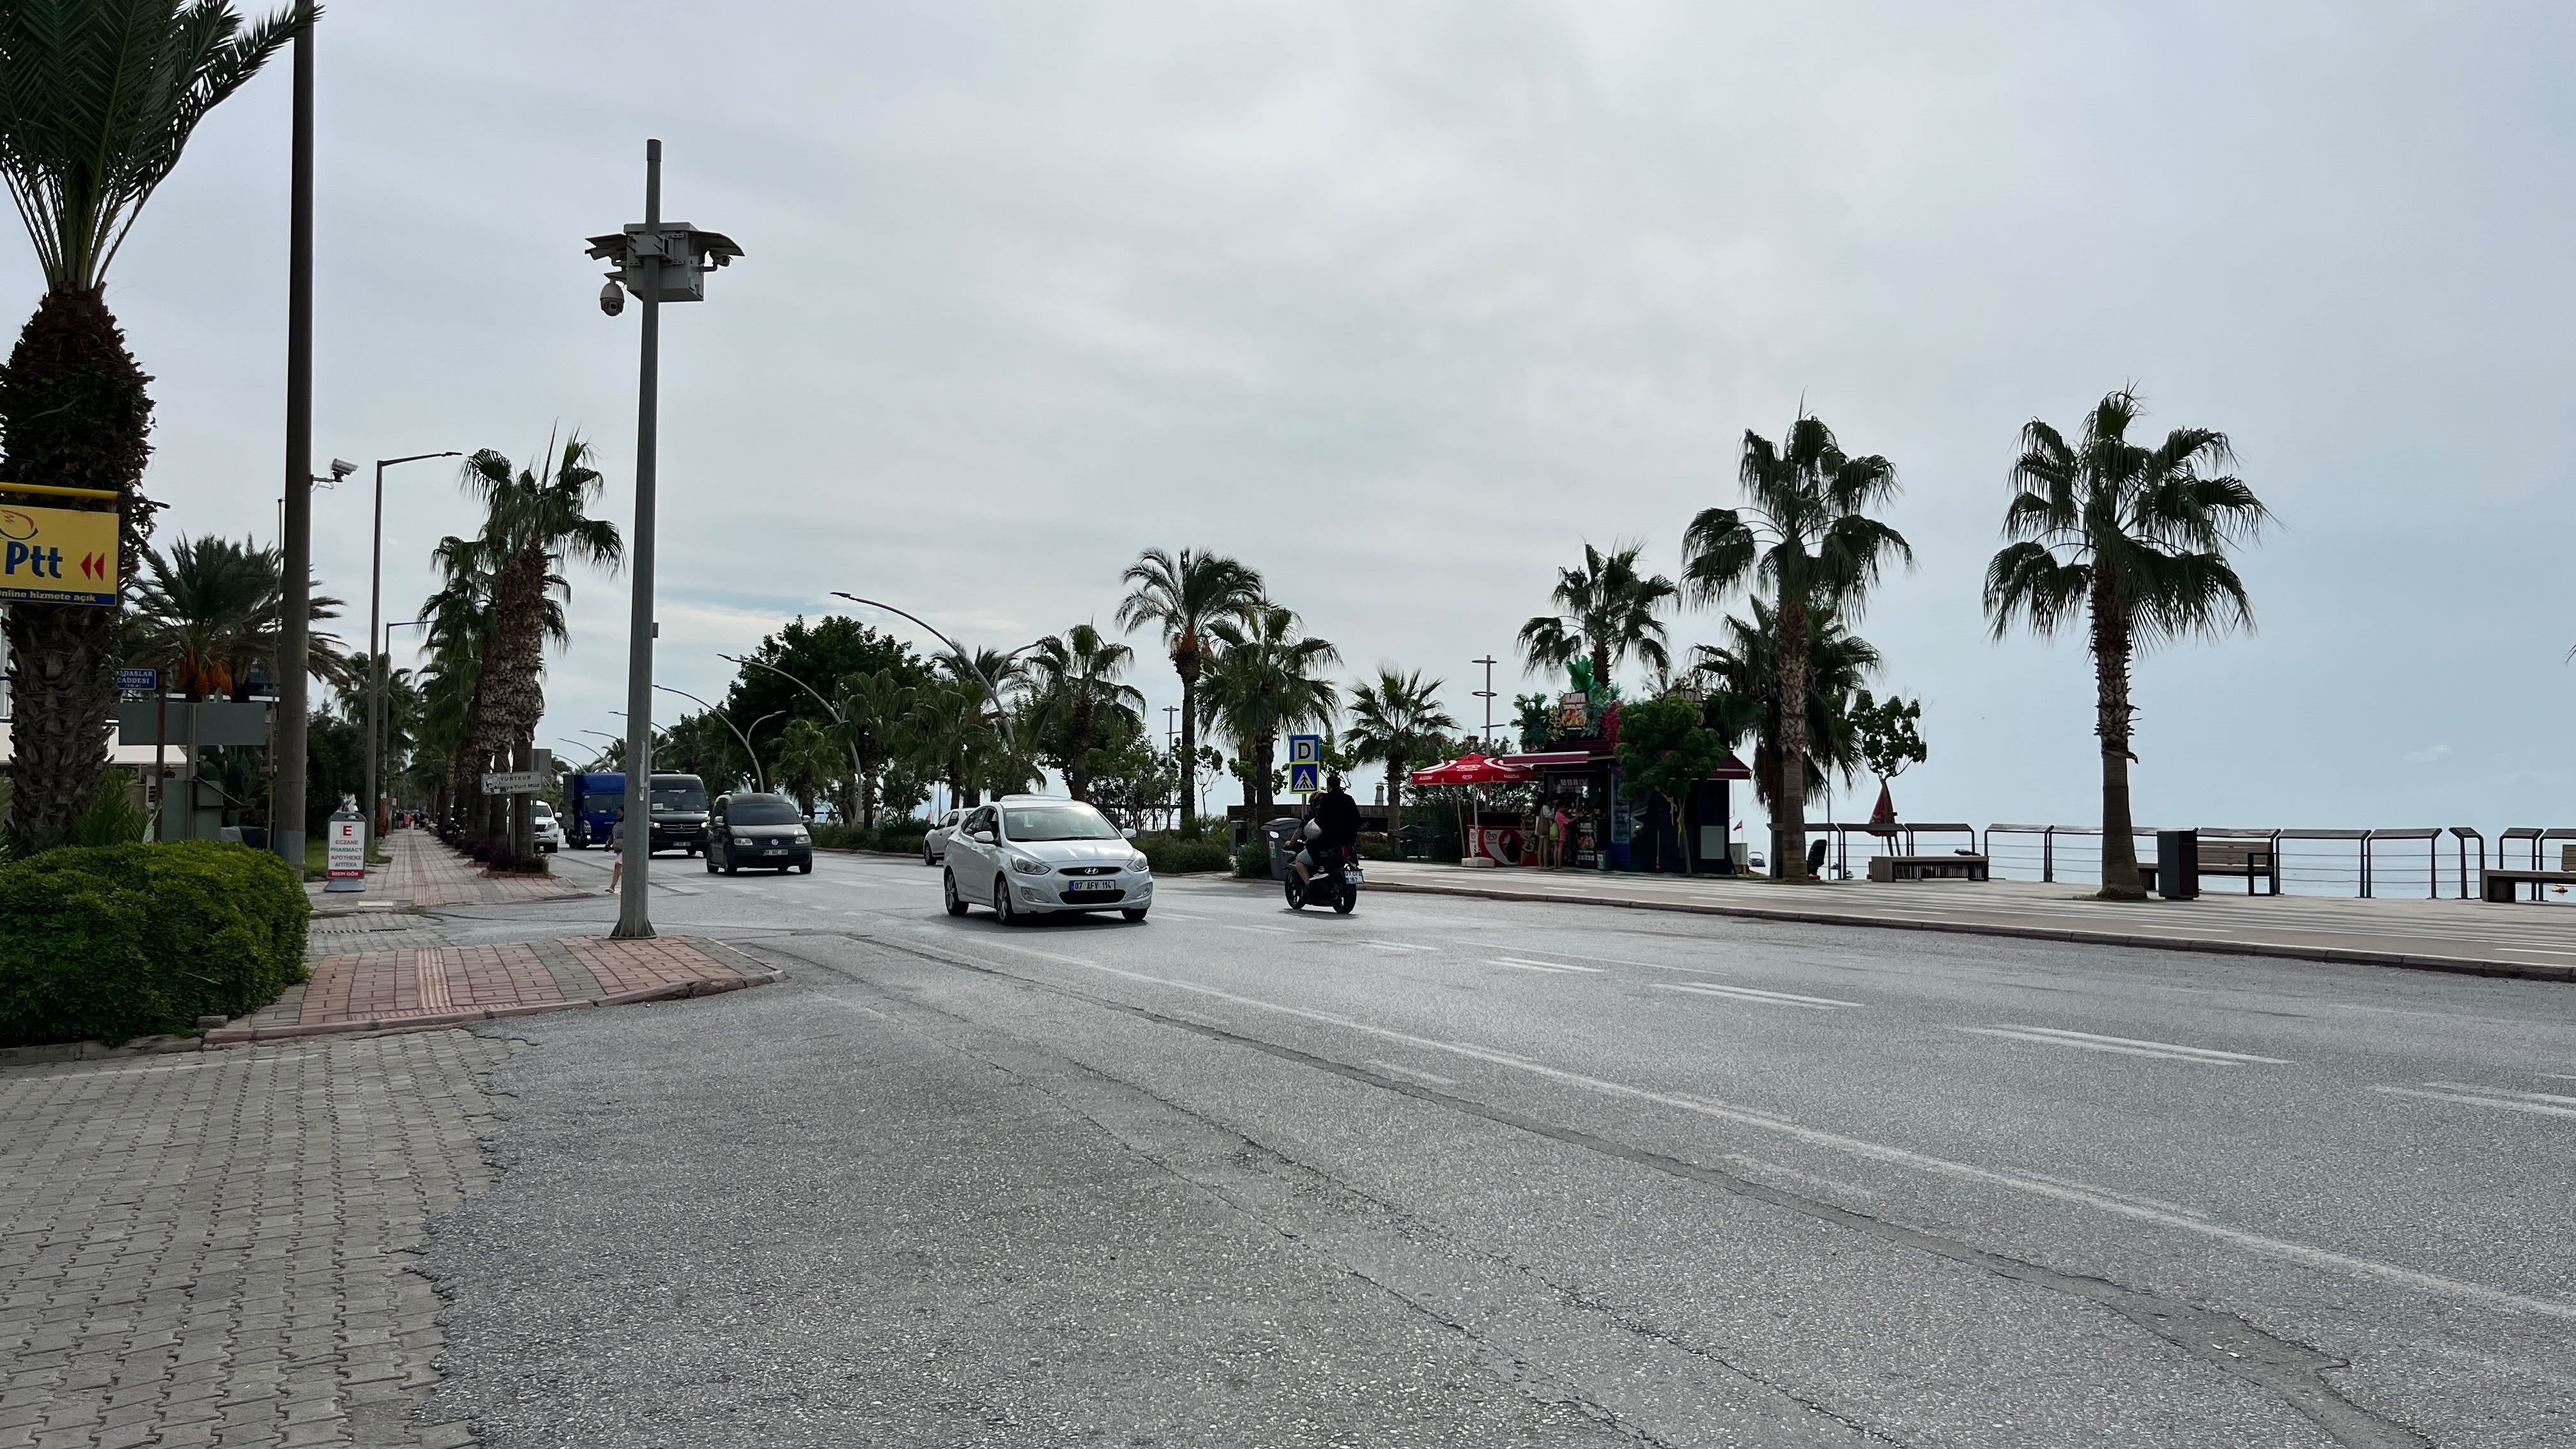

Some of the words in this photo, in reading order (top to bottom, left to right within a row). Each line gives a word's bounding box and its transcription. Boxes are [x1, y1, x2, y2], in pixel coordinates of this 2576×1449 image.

[5, 540, 63, 579] Ptt
[0, 590, 27, 598] nline
[30, 592, 72, 601] hizmete
[73, 594, 95, 602] açık
[1298, 742, 1311, 759] D
[343, 825, 352, 836] E
